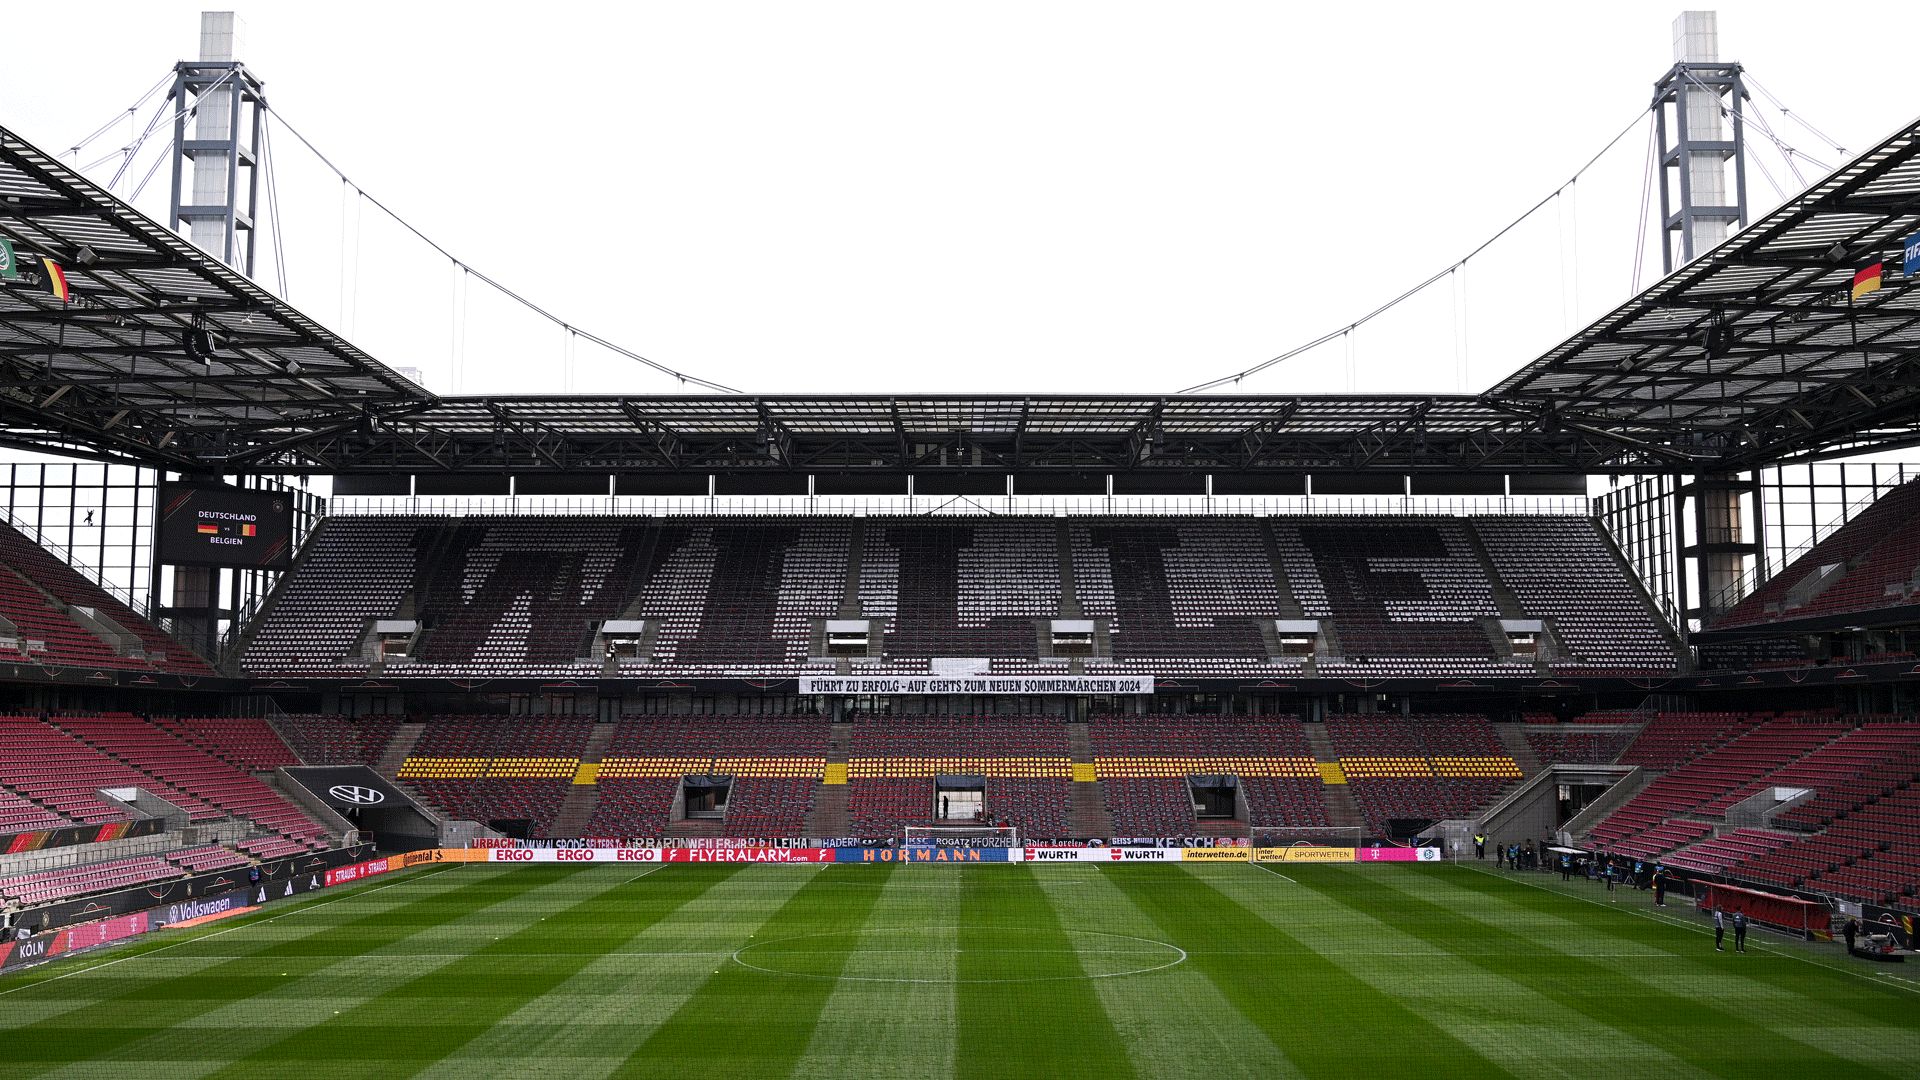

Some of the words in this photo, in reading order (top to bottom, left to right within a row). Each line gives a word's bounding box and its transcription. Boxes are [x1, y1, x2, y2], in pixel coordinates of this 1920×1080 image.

[1905, 240, 1920, 263] FIF
[198, 510, 257, 522] DEUTSCHLAND
[210, 536, 243, 546] BELGIEN
[810, 677, 843, 692] FÜHRT
[846, 680, 859, 692] ZU
[862, 680, 900, 692] ERFOLG
[907, 680, 927, 692] AUF
[929, 680, 962, 692] GEHTS
[964, 680, 987, 692] ZUM
[989, 680, 1022, 692] NEUEN
[1024, 677, 1117, 692] SOMMERMÄRCHEN
[1118, 680, 1140, 692] 2024
[471, 838, 515, 848] URBACH
[936, 838, 970, 847] ROGATZ
[971, 837, 1021, 848] PFORZHEIM
[1025, 838, 1049, 848] Adler
[1155, 838, 1214, 848] KESCH
[496, 849, 534, 861] ERGO
[556, 849, 594, 861] ERGO
[617, 849, 655, 861] ERGO
[689, 849, 808, 861] FLYERALARM.com
[863, 848, 981, 861] HÖRMANN
[1037, 850, 1078, 859] WÜRTH
[1124, 850, 1164, 859] WÜRTH
[1187, 849, 1248, 858] interwetten.de
[368, 860, 387, 874] STRAUSS
[335, 867, 356, 882] STRAUSS
[180, 897, 230, 921] Volkswagen
[19, 940, 44, 959] KÖLN
